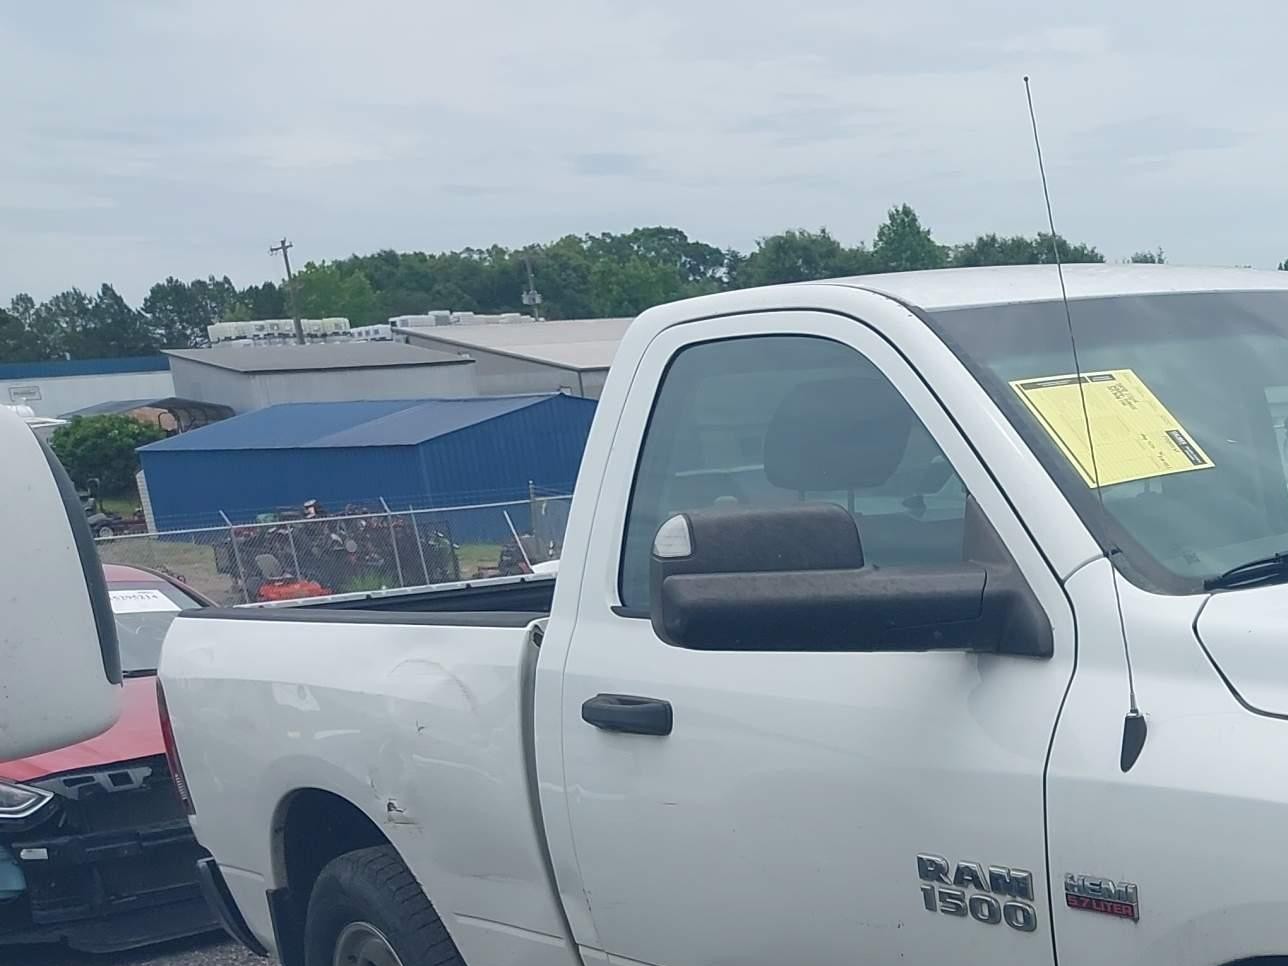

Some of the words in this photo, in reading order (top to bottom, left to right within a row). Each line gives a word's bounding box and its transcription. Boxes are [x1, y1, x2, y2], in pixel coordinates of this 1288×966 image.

[916, 852, 1035, 902] RAM
[1064, 872, 1138, 905] HEMI
[920, 884, 1038, 933] 1500
[1067, 895, 1090, 908] 5.7
[1092, 899, 1134, 918] LITER
